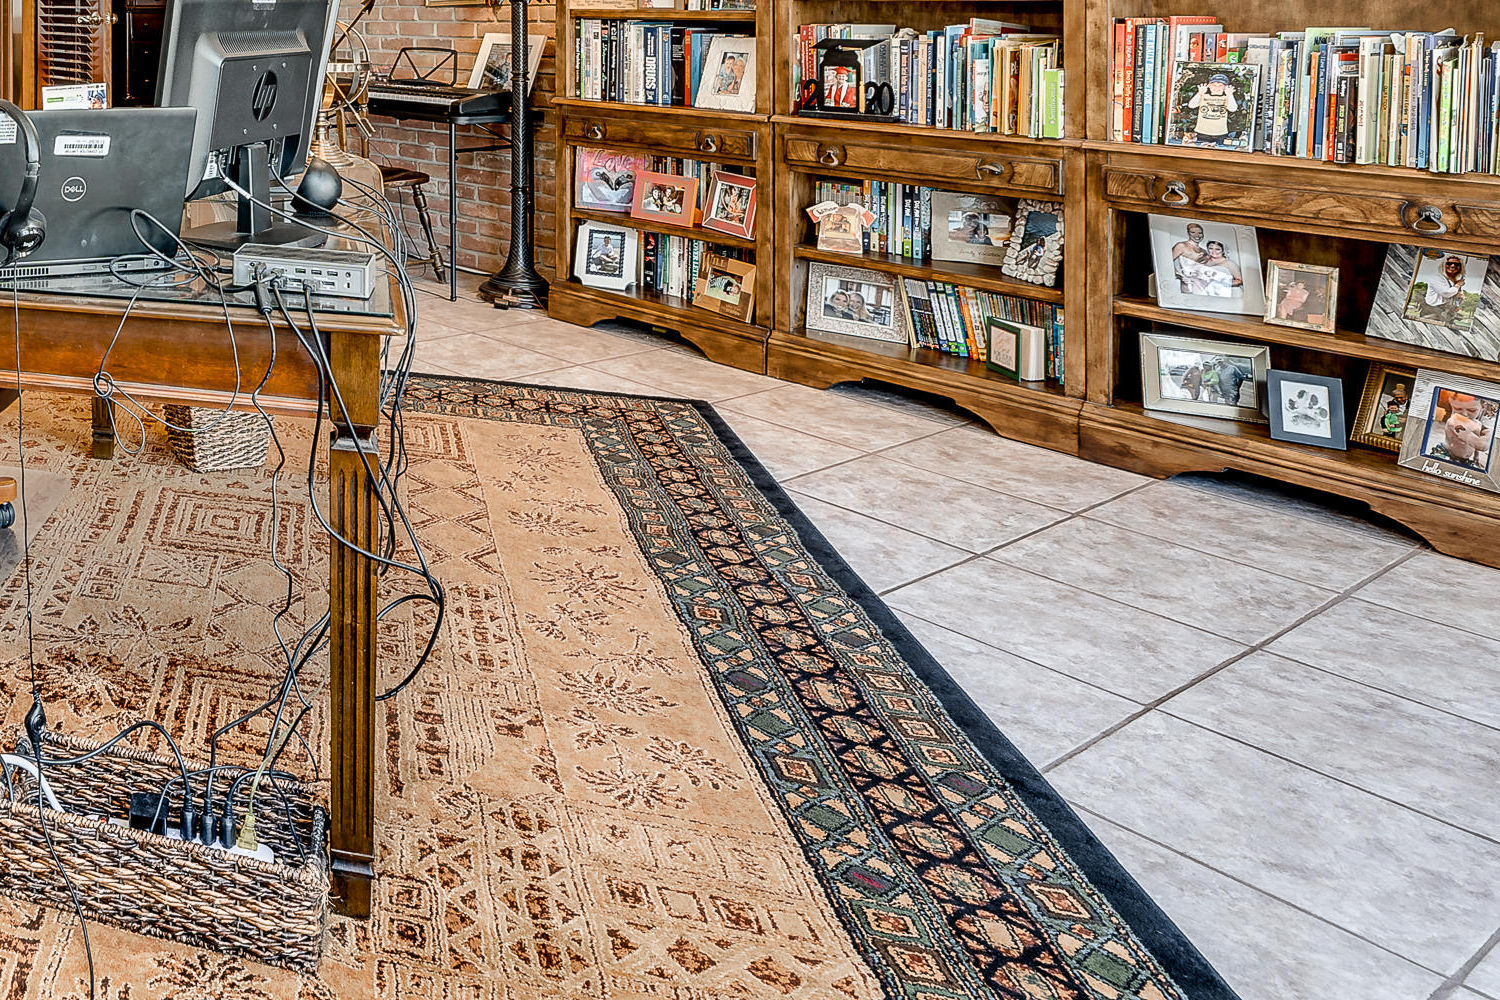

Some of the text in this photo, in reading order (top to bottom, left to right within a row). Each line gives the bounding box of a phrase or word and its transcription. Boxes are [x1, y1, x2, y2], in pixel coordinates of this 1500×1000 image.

[645, 56, 657, 89] DRUGS
[253, 72, 277, 121] hp
[1135, 90, 1143, 105] Great
[1134, 105, 1142, 132] Dinosaurs
[593, 150, 635, 173] Love
[64, 185, 84, 193] DELL
[1421, 459, 1481, 486] hello sunshine
